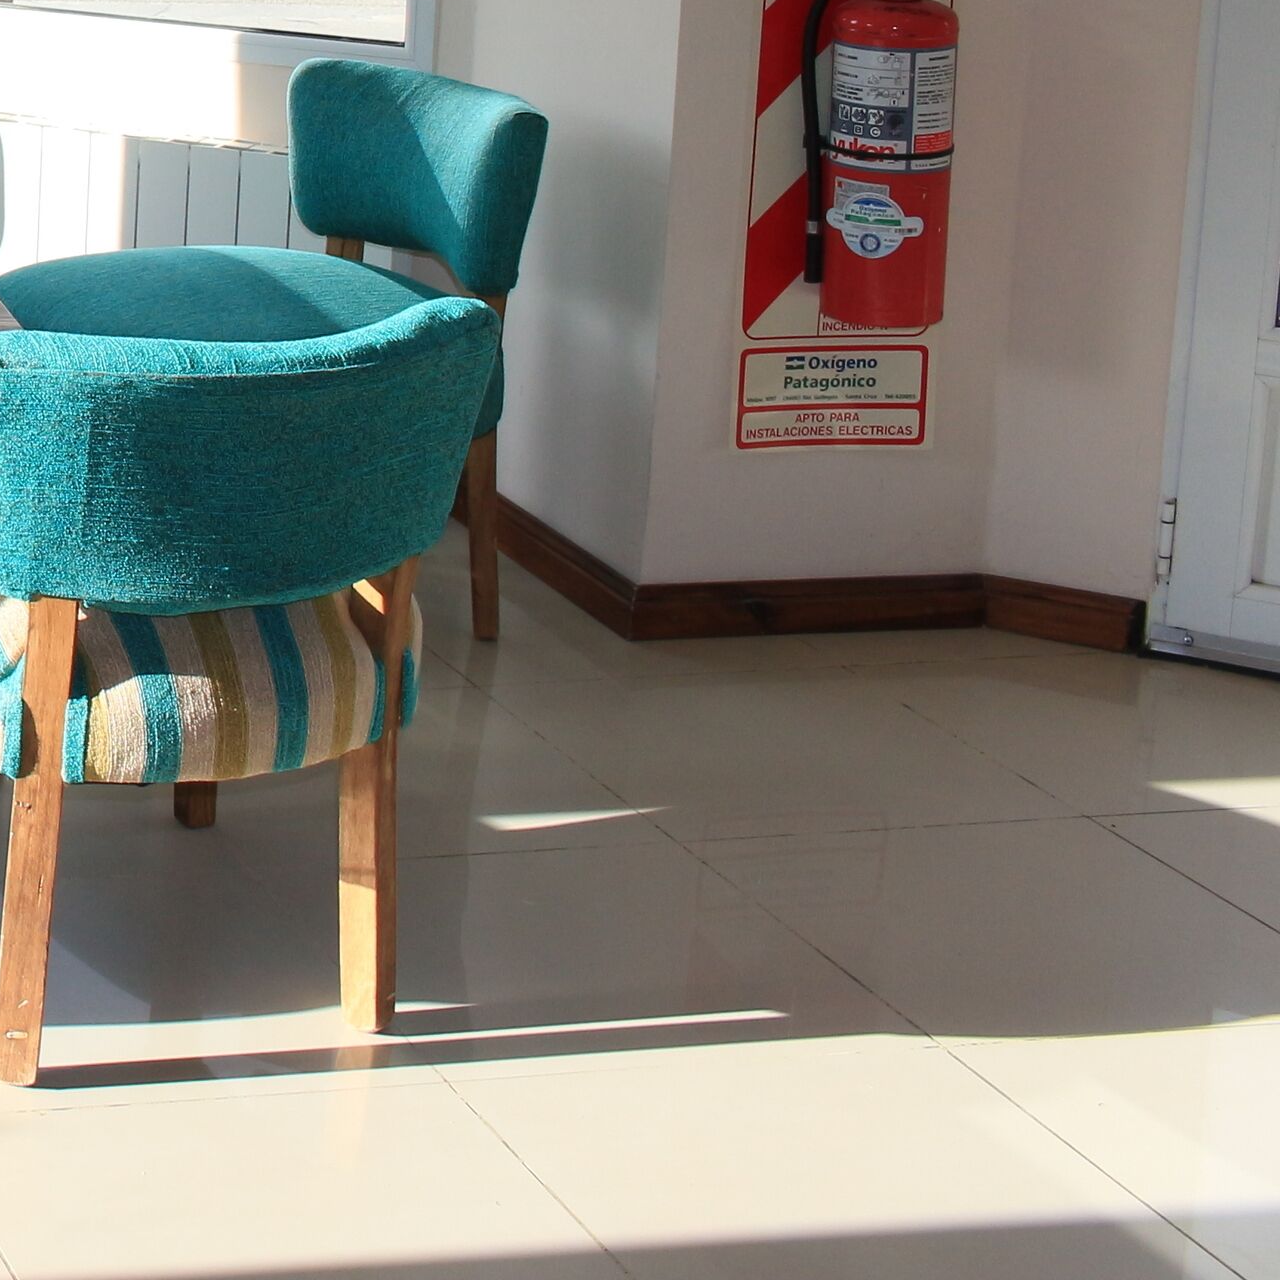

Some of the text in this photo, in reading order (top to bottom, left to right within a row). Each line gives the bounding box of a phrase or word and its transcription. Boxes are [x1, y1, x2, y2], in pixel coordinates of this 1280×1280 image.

[809, 354, 878, 372] Oxígeno
[783, 373, 877, 391] Patagónico
[795, 412, 860, 423] APTO PARA
[746, 425, 913, 439] INSTALACIONES ELECTRICAS
